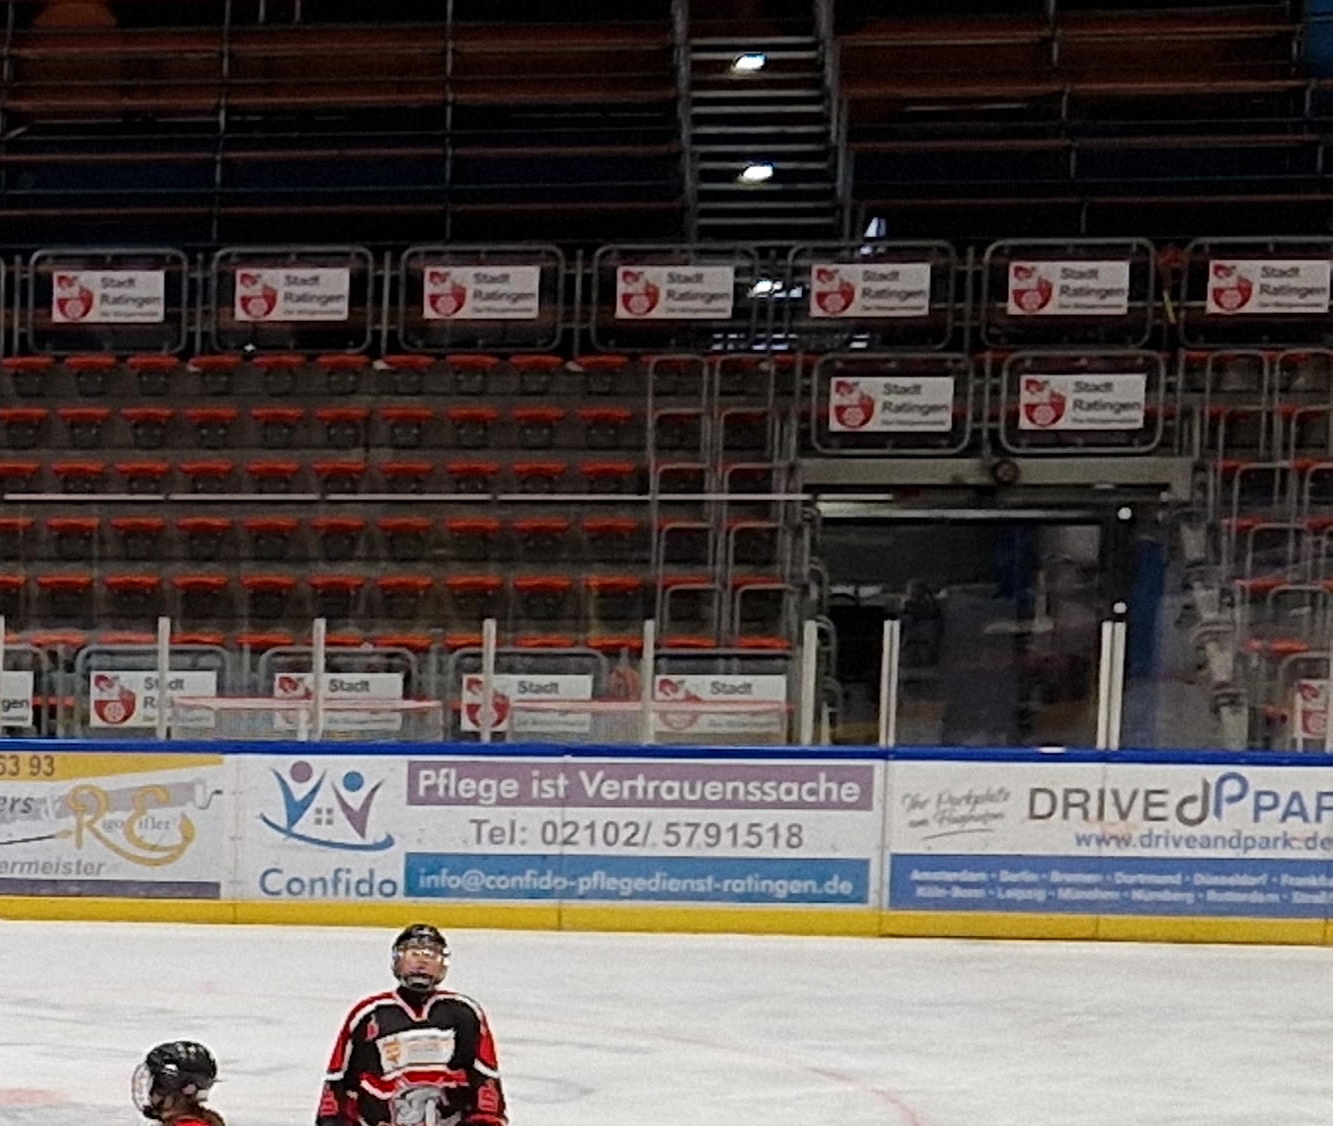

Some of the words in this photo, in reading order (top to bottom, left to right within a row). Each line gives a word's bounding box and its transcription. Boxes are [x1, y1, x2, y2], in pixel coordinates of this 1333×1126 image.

[328, 678, 371, 694] Stadt
[518, 680, 560, 695] Stadt
[710, 680, 753, 695] Stadt
[28, 755, 56, 777] 93
[417, 768, 520, 805] Pflege
[531, 770, 568, 799] ist
[580, 771, 861, 804] Vertrauenssache
[469, 817, 528, 846] Tel:
[540, 819, 654, 847] 02102/
[664, 821, 804, 849] 5791518
[258, 867, 399, 898] Confido
[418, 867, 854, 898] info@confido-pflegedienst-ratingen.de
